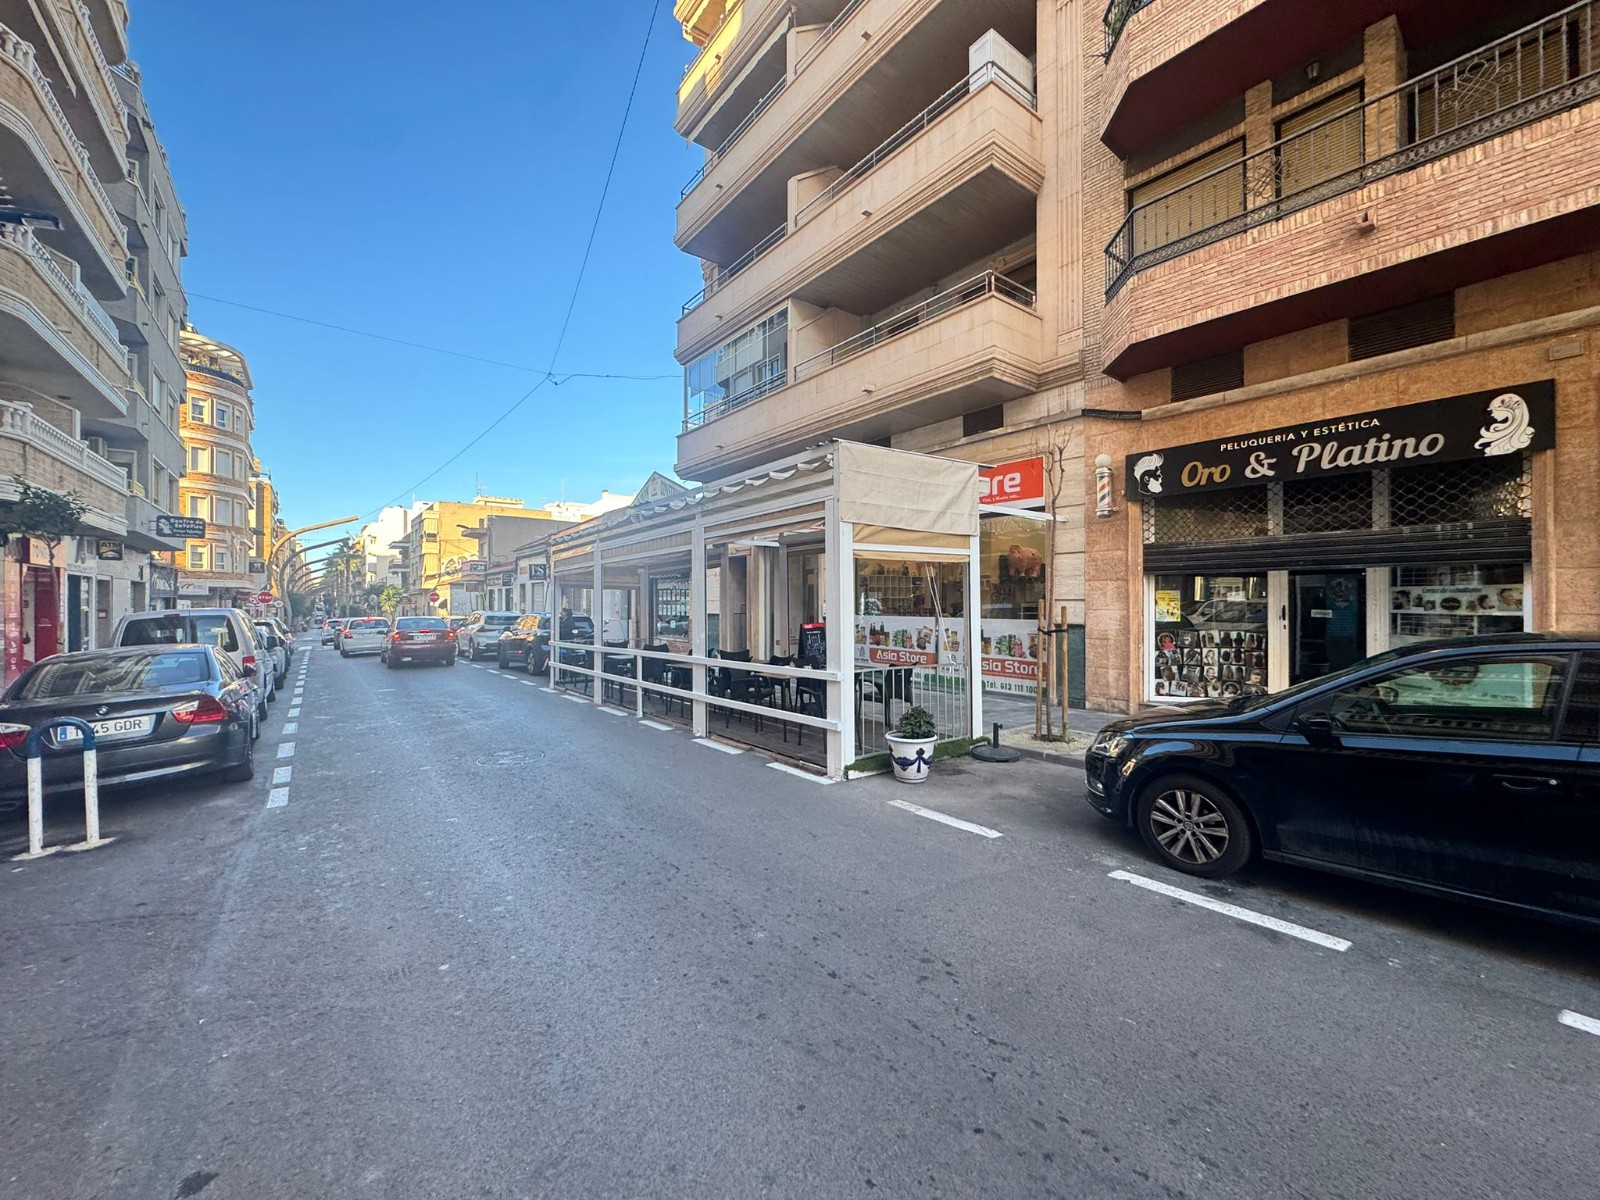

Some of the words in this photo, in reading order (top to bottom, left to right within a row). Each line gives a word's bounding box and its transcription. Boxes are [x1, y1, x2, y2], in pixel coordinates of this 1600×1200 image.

[1220, 432, 1296, 451] PELUQUERIA
[1301, 430, 1309, 438] Y
[1314, 418, 1381, 437] ESTÉTICA
[1181, 461, 1231, 487] Oro
[1244, 451, 1277, 478] &
[1292, 433, 1445, 473] Platino
[978, 472, 1021, 497] ore
[876, 650, 897, 660] Asia
[899, 651, 927, 663] Store
[982, 659, 1001, 672] sia
[986, 680, 998, 689] Tel.
[1000, 682, 1011, 690] 613
[1014, 684, 1023, 692] 111
[74, 723, 109, 736] 145
[114, 719, 142, 732] GDR
